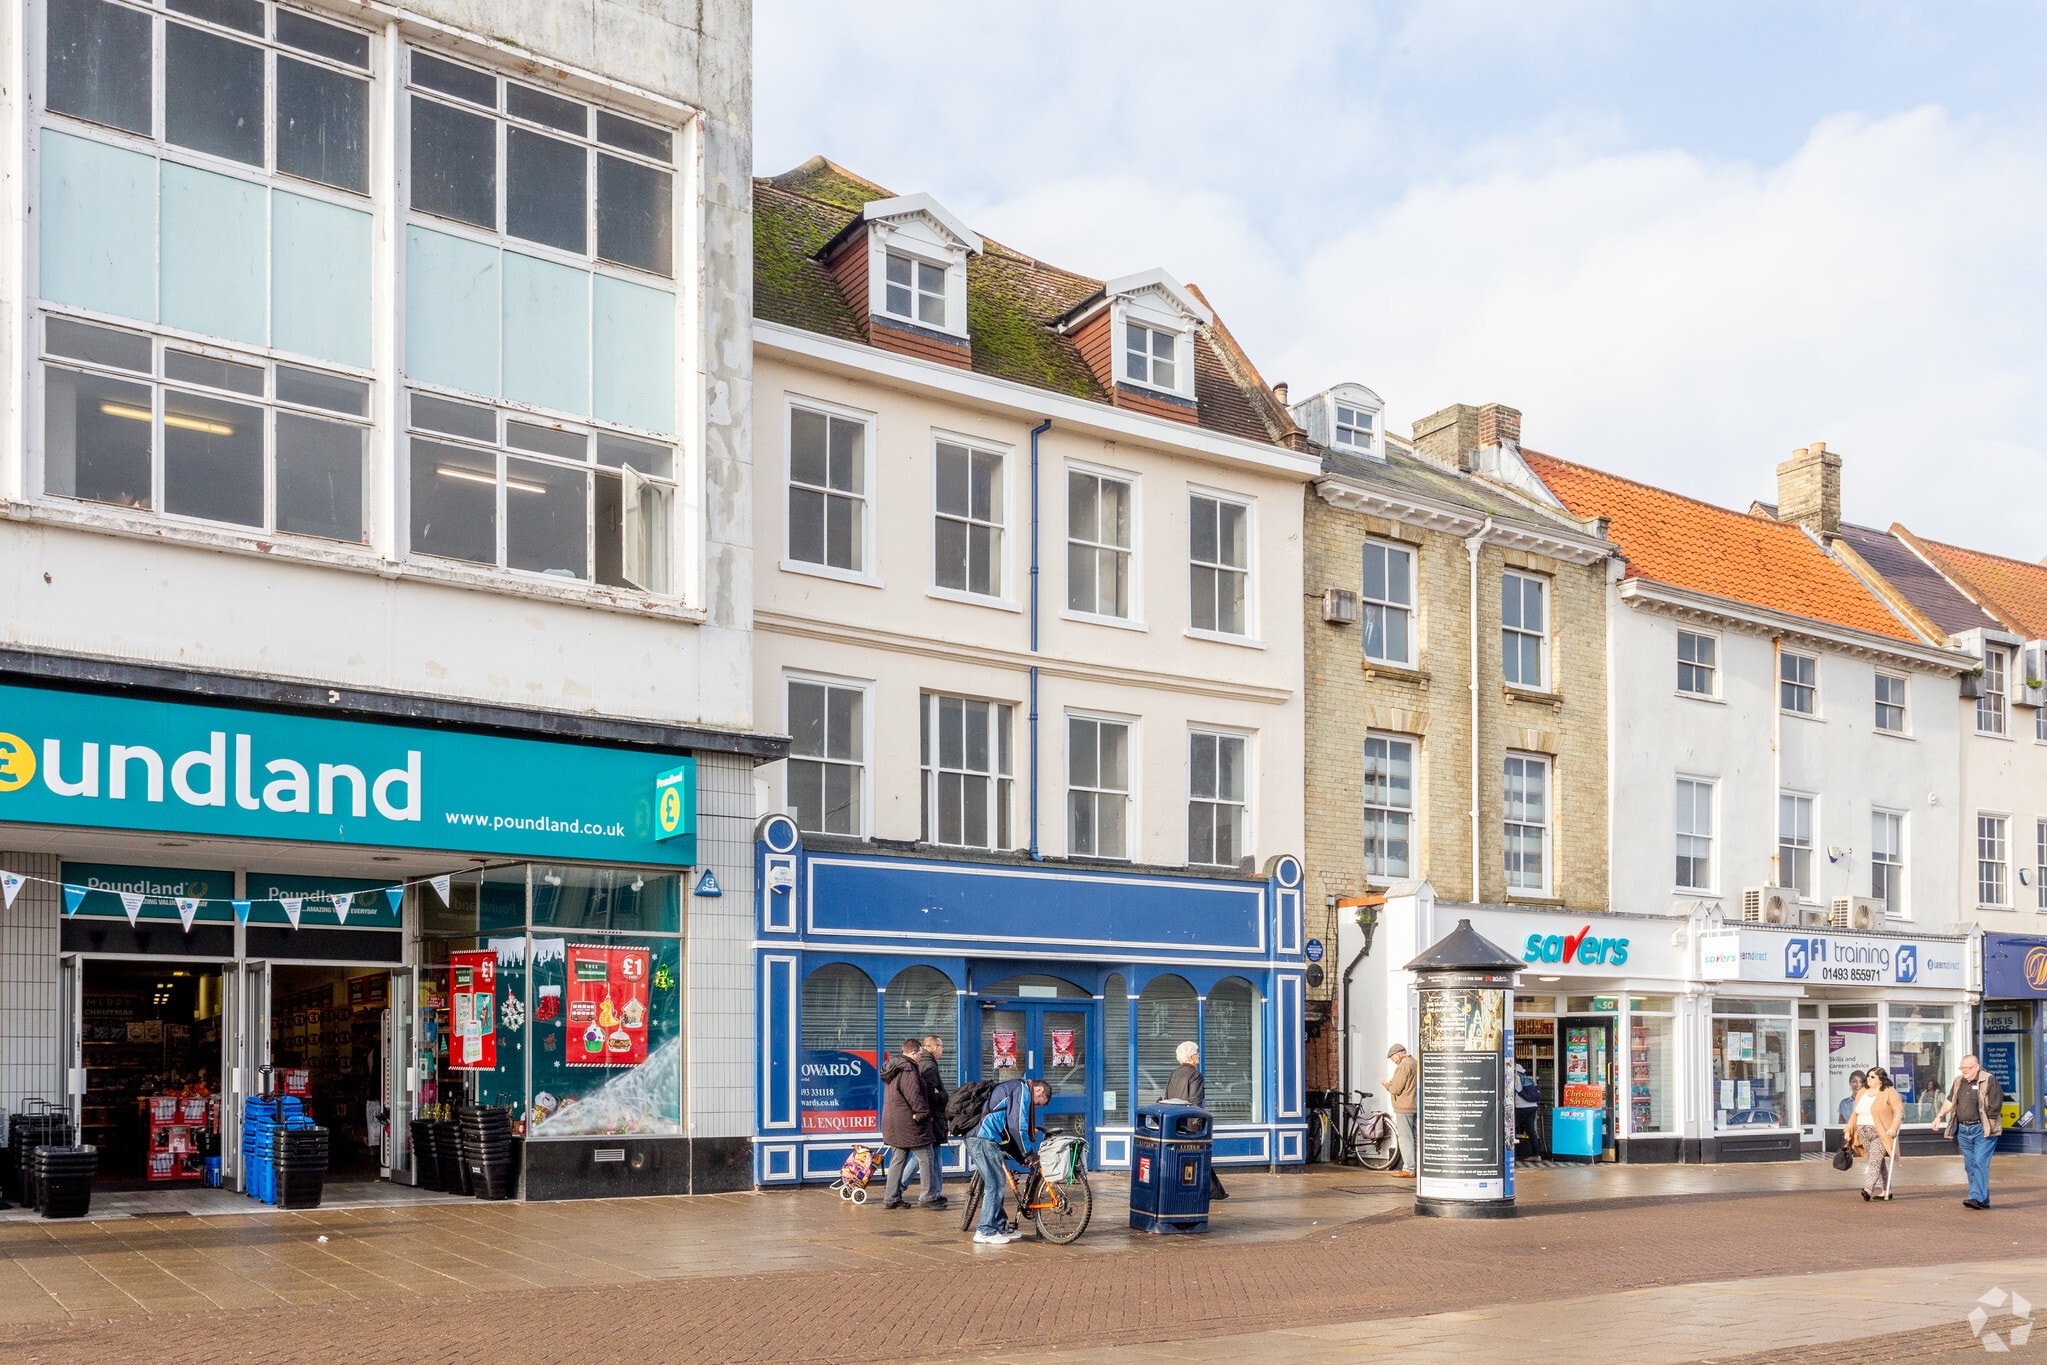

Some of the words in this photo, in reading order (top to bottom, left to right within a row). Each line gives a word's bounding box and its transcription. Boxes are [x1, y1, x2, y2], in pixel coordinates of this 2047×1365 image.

[445, 812, 625, 837] www.poundland.co.uk
[87, 876, 185, 896] Poundland
[1521, 925, 1630, 966] savers
[1704, 952, 1737, 964] savers
[1834, 941, 1890, 972] training
[481, 960, 494, 978] £1
[622, 958, 642, 976] £1
[1822, 967, 1849, 980] 01493
[1850, 969, 1881, 982] 855971
[86, 999, 132, 1007] MERRY
[2004, 1017, 2013, 1025] IS
[801, 1059, 862, 1077] OWARDS
[811, 1088, 835, 1097] 331118
[1565, 1089, 1601, 1099] Christmas
[1569, 1098, 1597, 1106] Savings
[1560, 1110, 1585, 1118] savers
